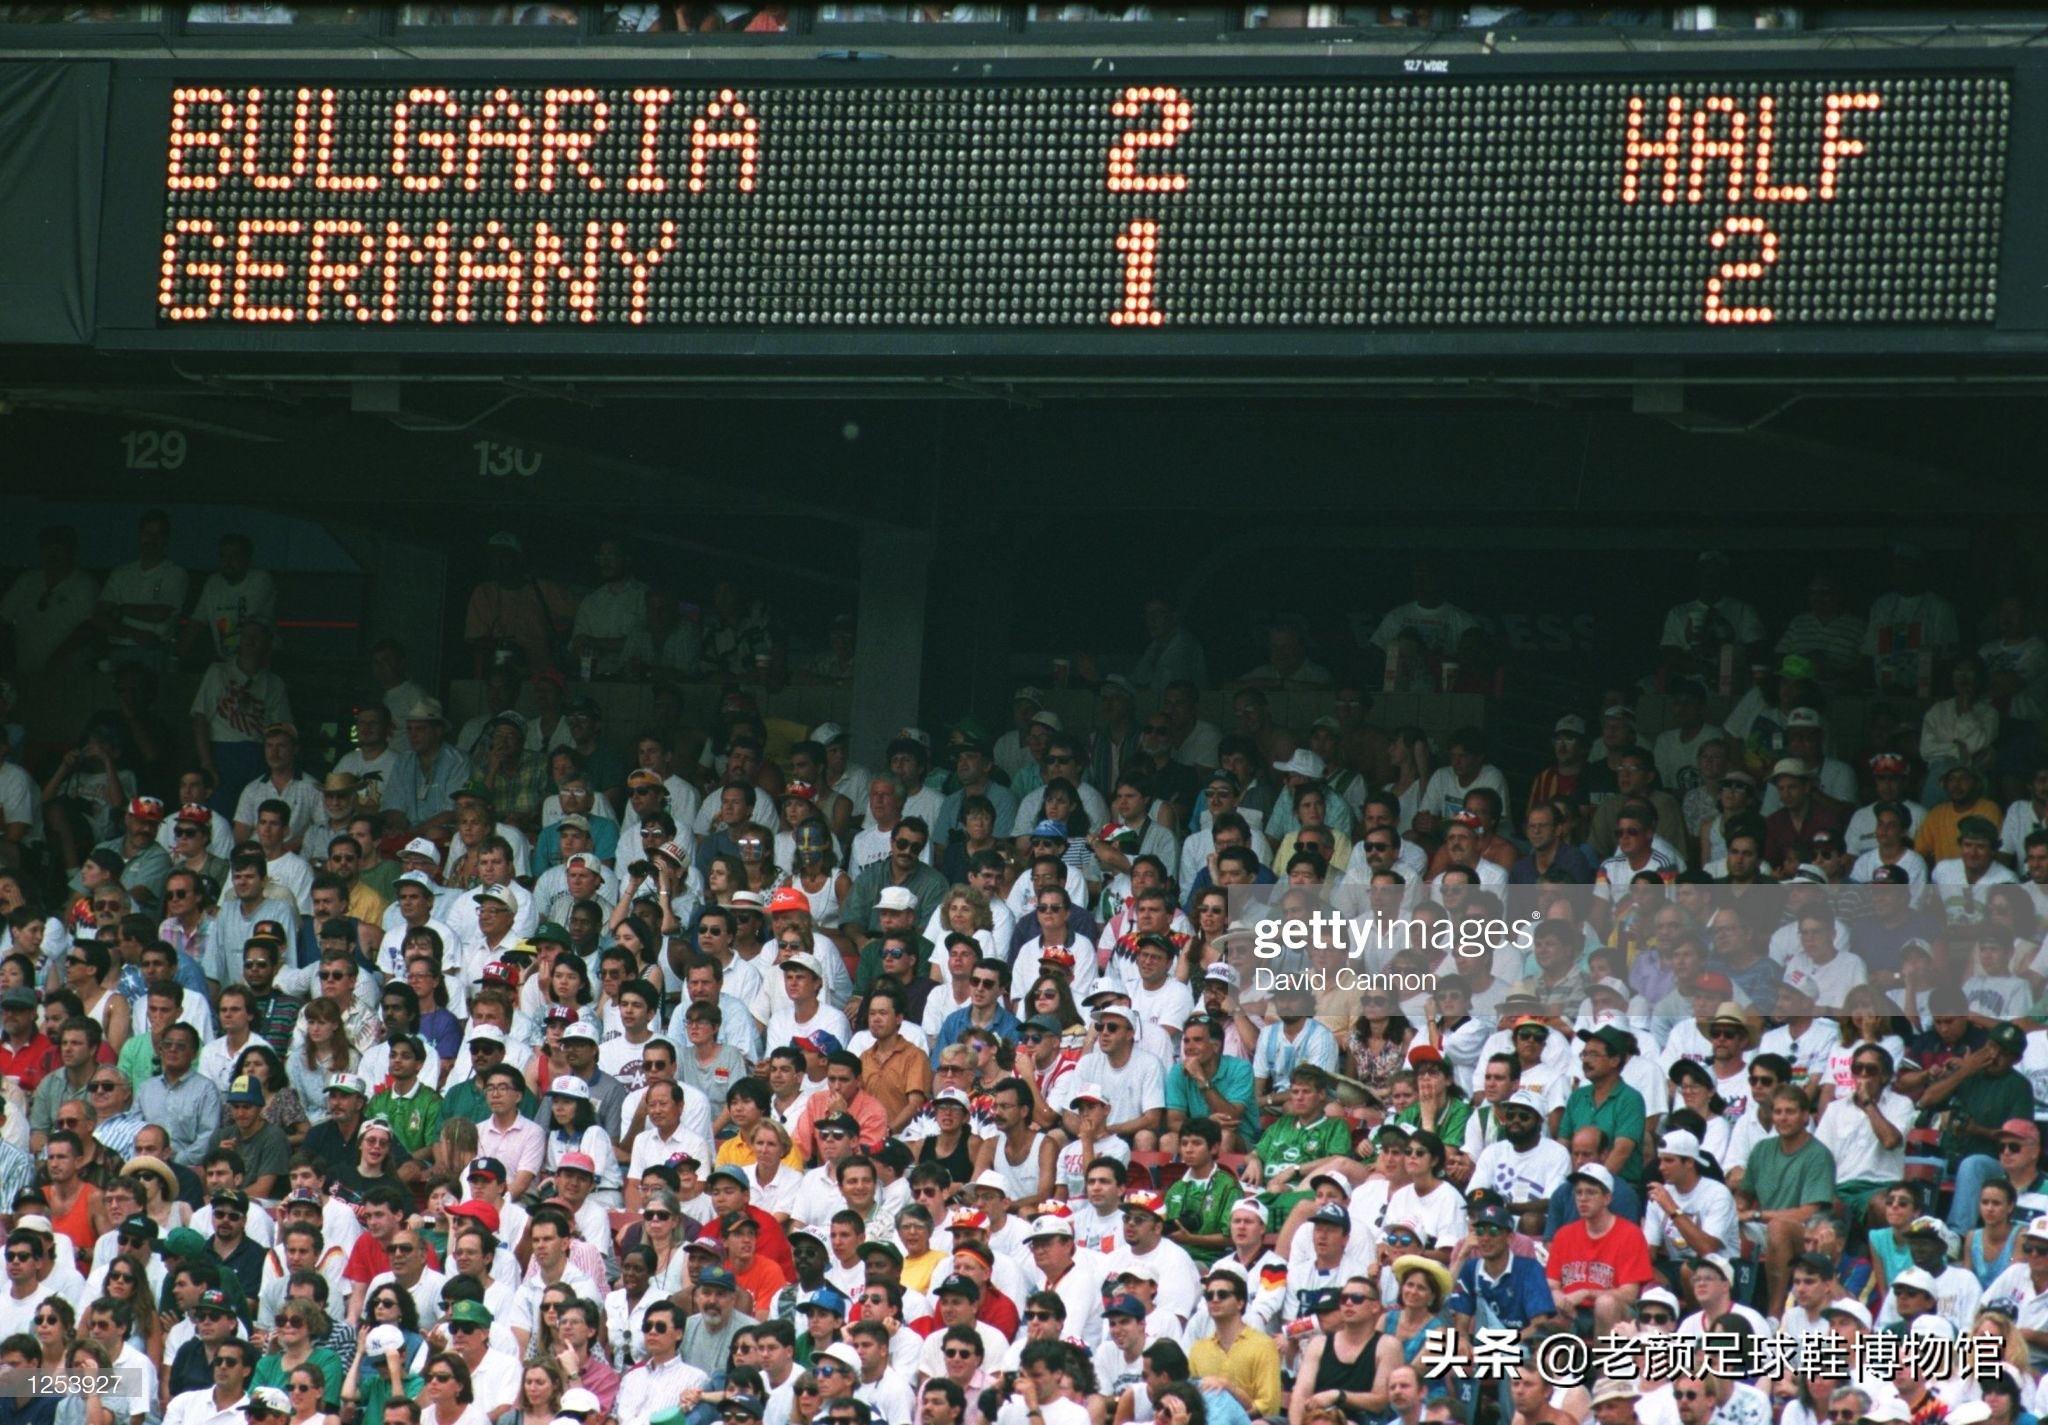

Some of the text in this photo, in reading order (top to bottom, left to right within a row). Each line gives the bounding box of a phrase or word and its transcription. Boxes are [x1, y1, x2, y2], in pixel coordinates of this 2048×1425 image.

[167, 87, 760, 193] BULGARIA
[1107, 87, 1194, 192] 2
[1622, 92, 1882, 204] HALF
[158, 219, 679, 324] GERMANY
[1110, 219, 1167, 326] 1
[1704, 217, 1779, 324] 2
[120, 430, 188, 470] 129
